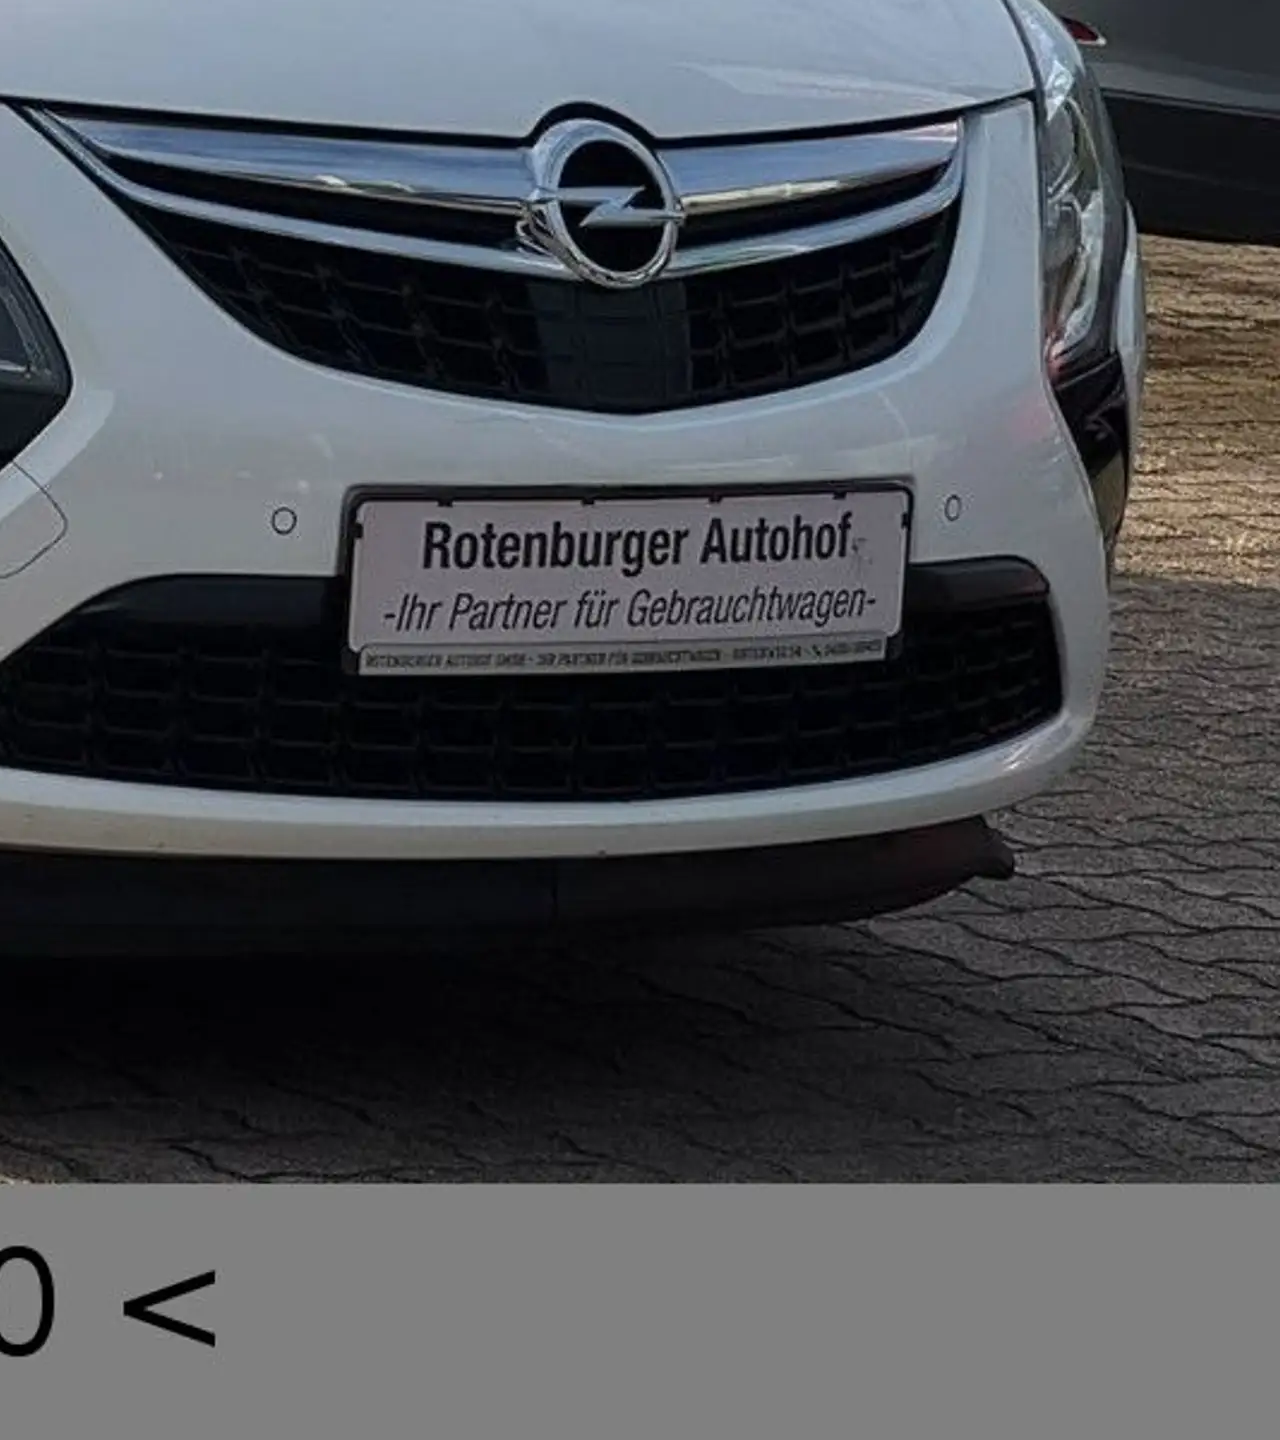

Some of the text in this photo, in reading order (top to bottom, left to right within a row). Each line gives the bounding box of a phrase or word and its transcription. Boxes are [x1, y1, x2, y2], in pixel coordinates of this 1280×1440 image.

[422, 512, 853, 578] Rotenburger Autohof
[448, 592, 567, 631] Partner
[572, 589, 618, 630] für
[627, 586, 877, 628] Gebrauchtwagen-
